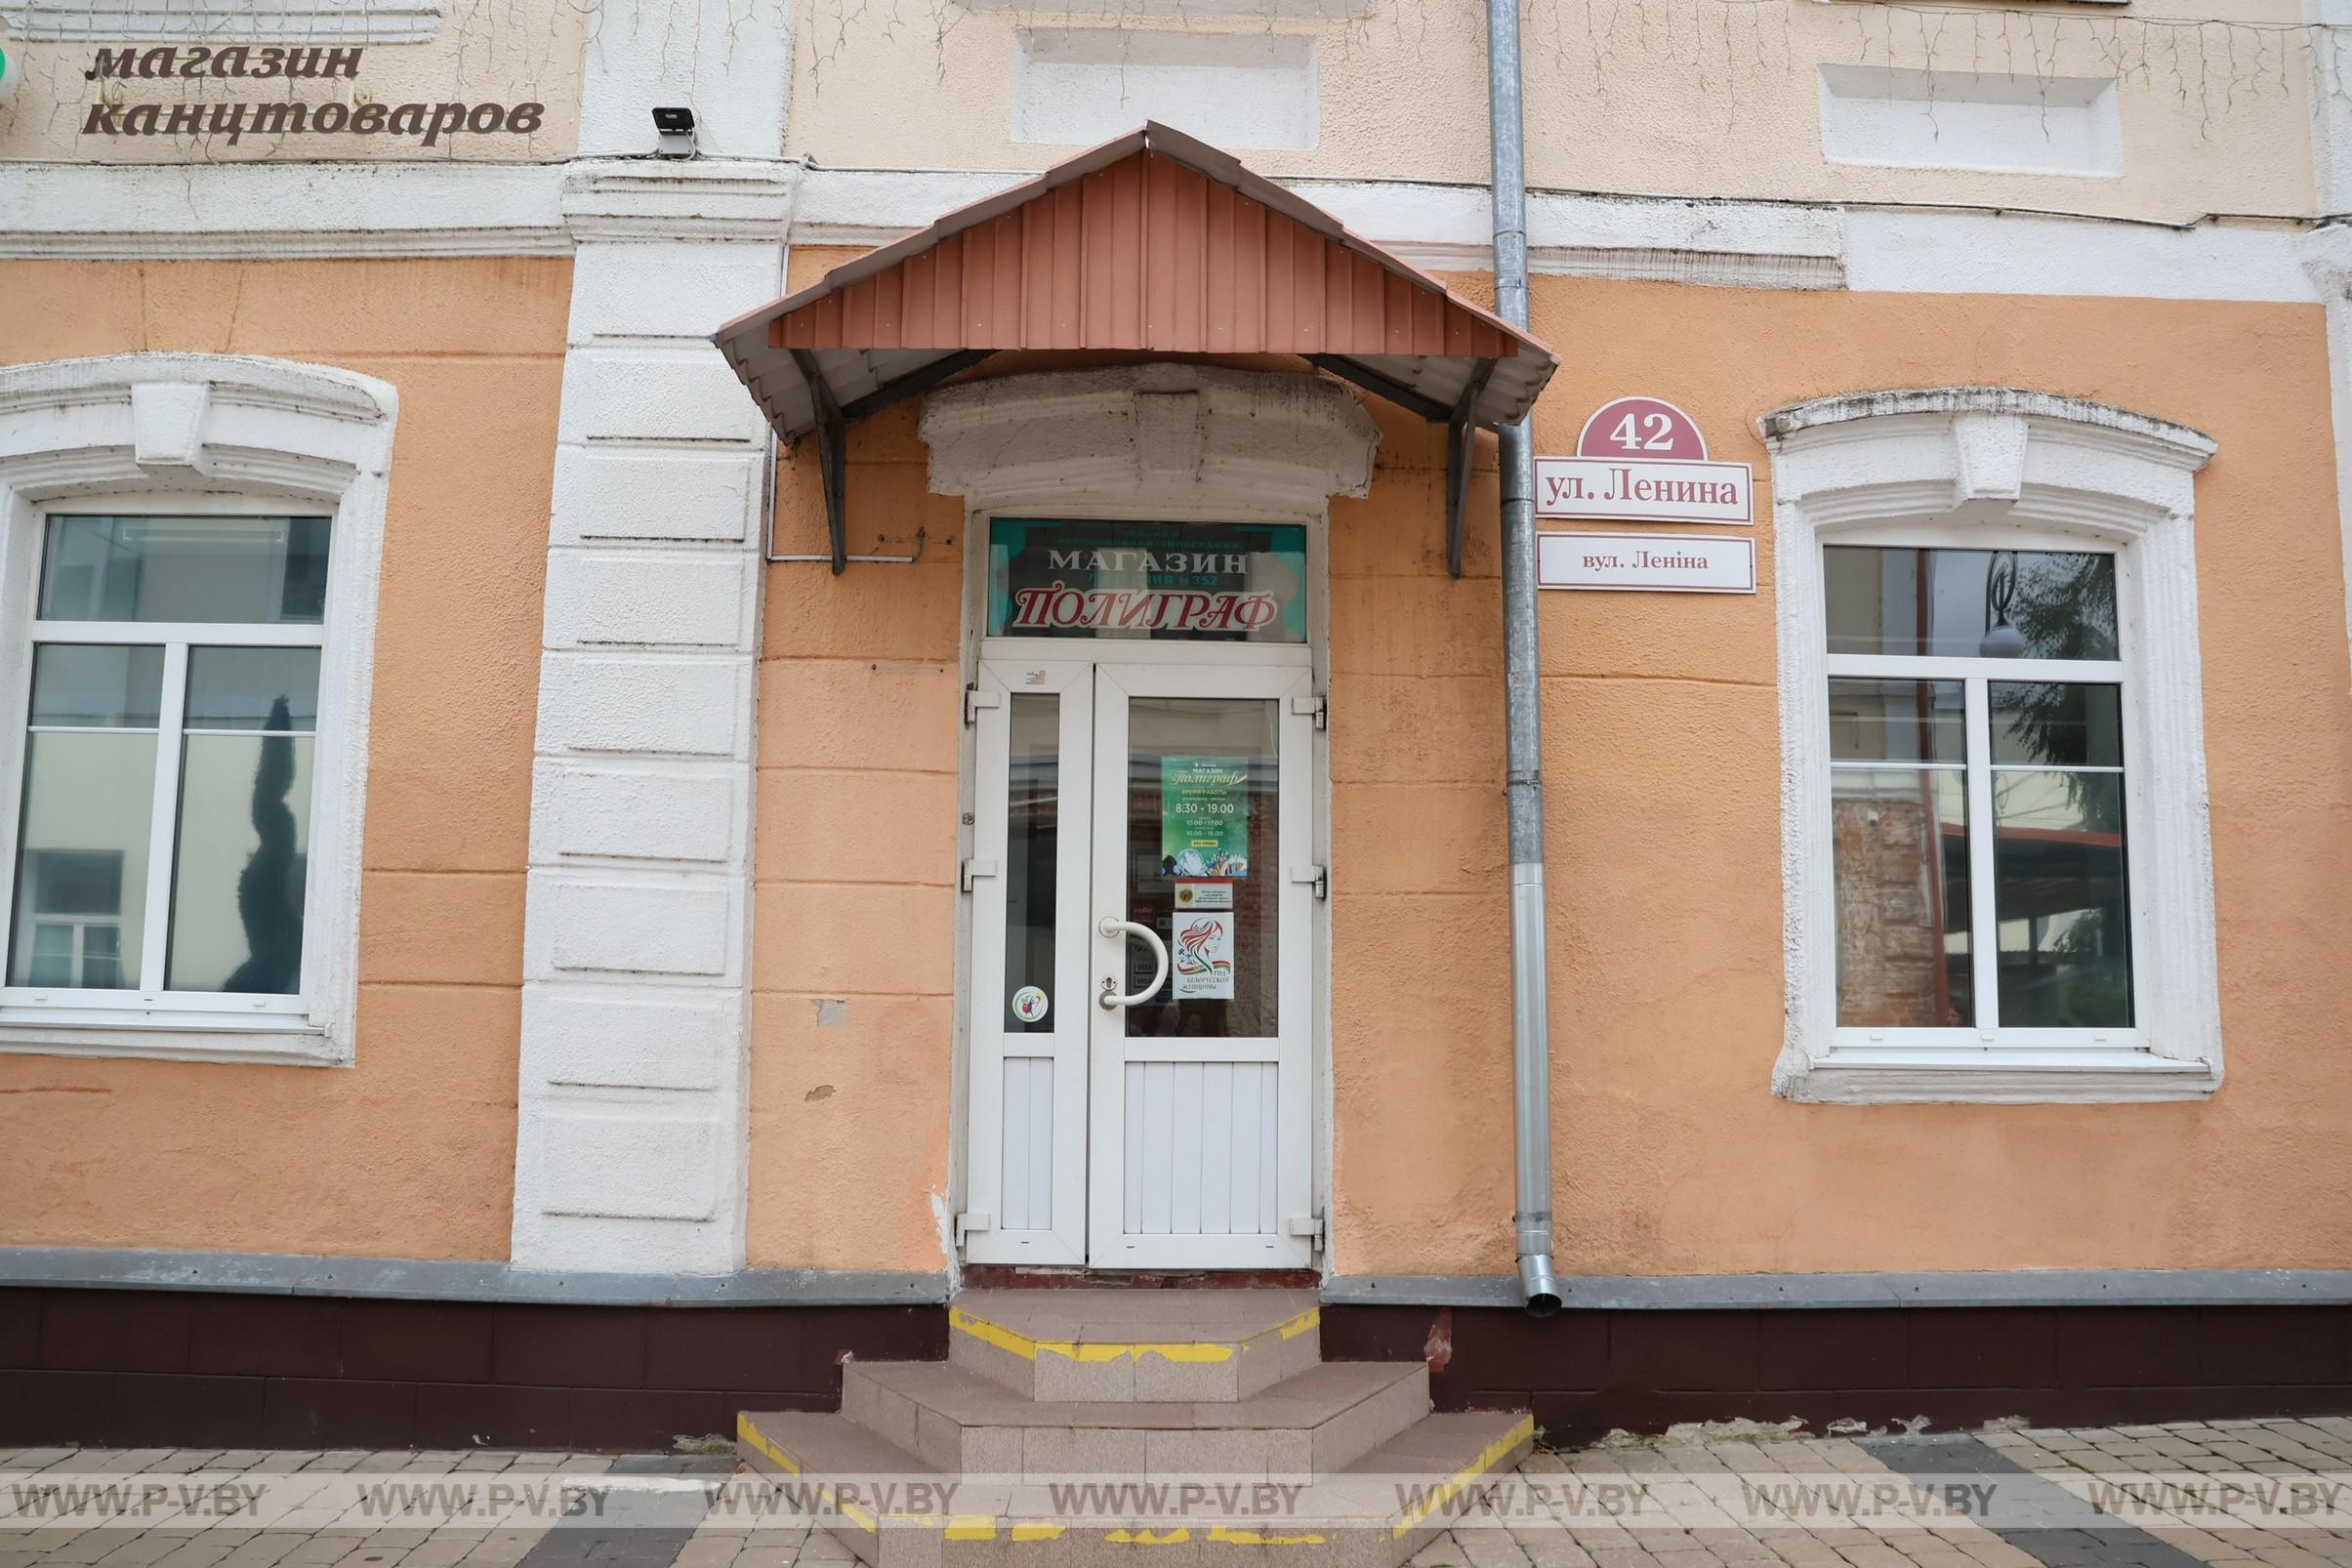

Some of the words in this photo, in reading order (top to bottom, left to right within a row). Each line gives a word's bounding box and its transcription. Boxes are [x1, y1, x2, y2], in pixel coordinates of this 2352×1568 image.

[84, 46, 364, 80] магазин
[81, 102, 545, 147] канцтоваров
[1609, 413, 1674, 451] 42
[1546, 476, 1595, 506] ул.
[1603, 468, 1739, 505] Ленина
[1048, 549, 1249, 574] МАГАЗИН
[1582, 555, 1625, 572] вул.
[1631, 551, 1709, 569] Леніна
[1013, 581, 1276, 630] ПОЛИГРАФ
[1176, 804, 1198, 813] 8.30
[1208, 804, 1234, 813] 19.00
